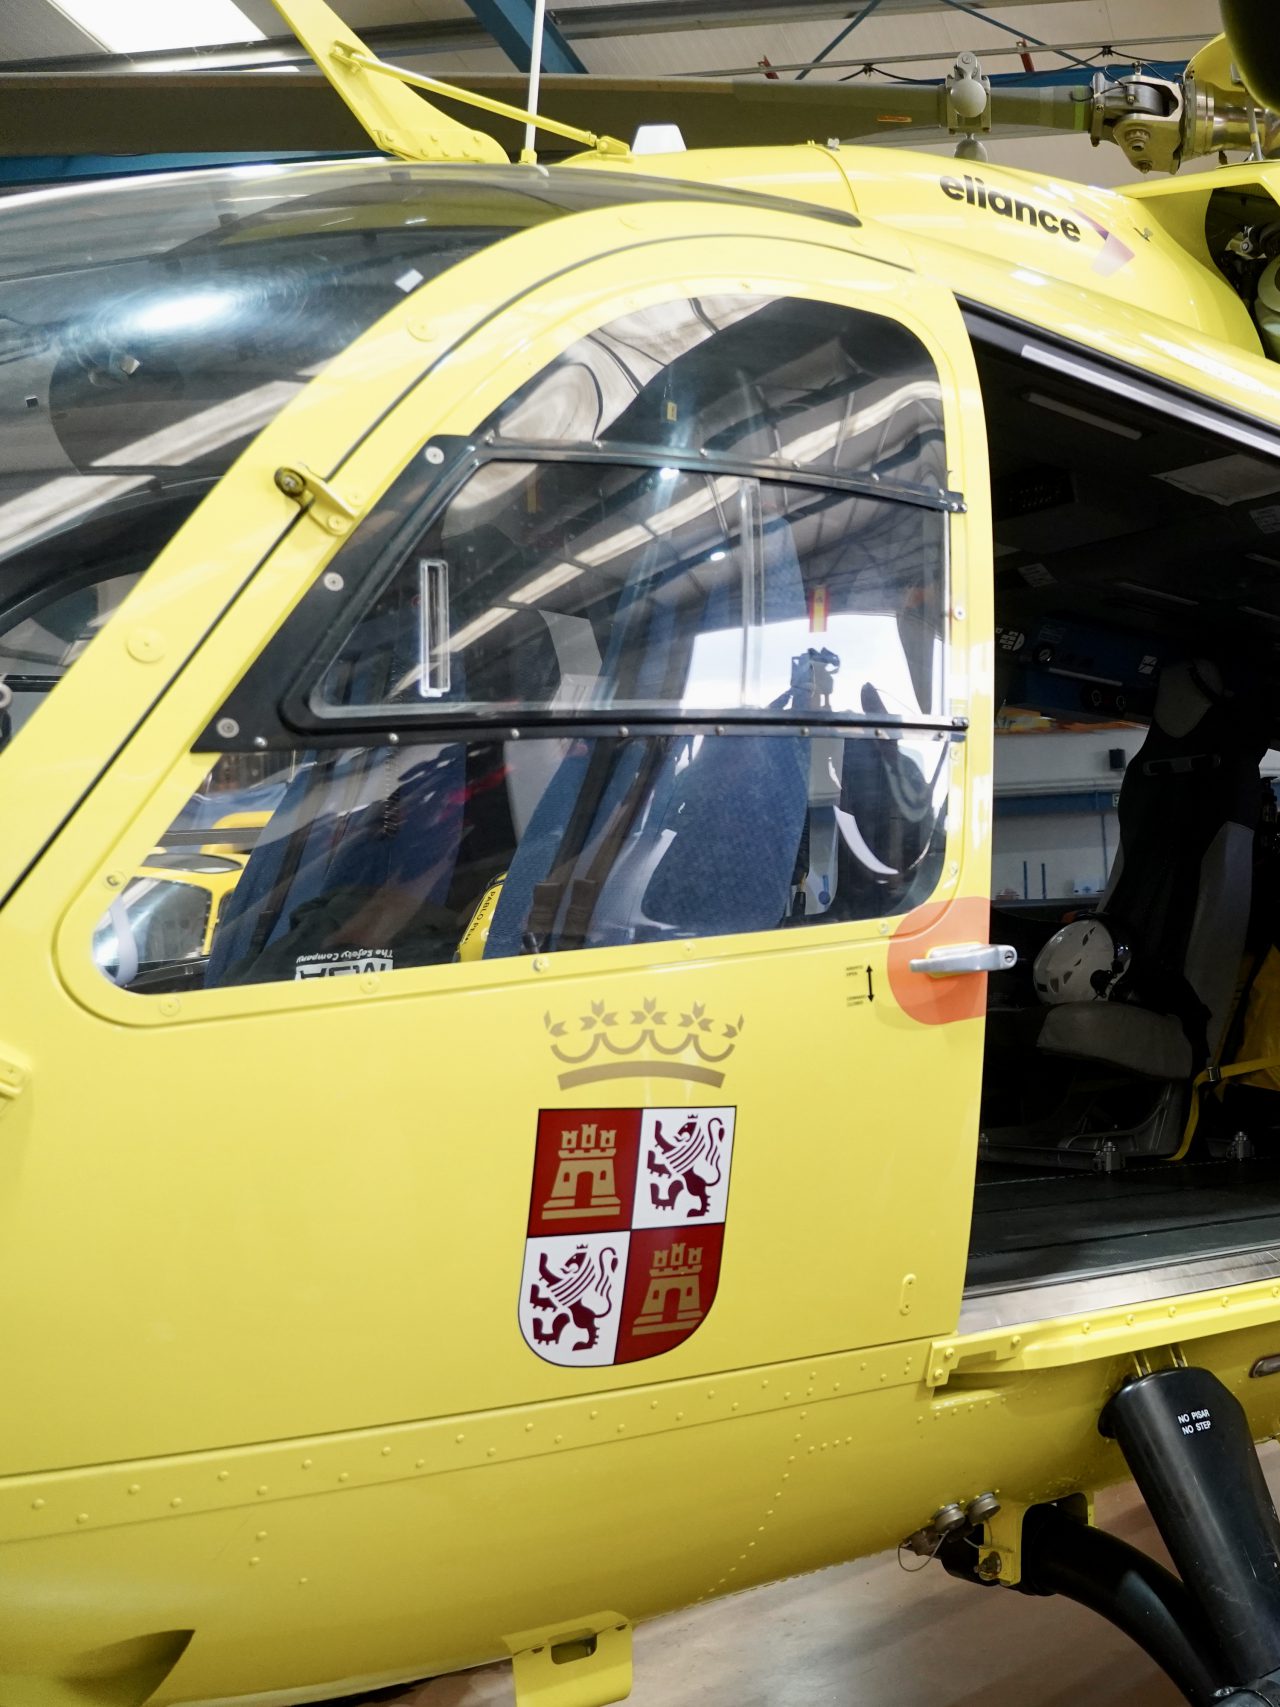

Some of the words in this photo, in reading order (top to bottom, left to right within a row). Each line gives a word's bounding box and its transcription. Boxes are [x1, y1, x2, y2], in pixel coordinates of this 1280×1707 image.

[939, 174, 1081, 242] eliance
[296, 952, 340, 964] Company
[341, 948, 373, 960] Safety
[375, 948, 394, 958] The
[1177, 1413, 1190, 1424] NO
[1191, 1409, 1211, 1420] PISAR
[1181, 1424, 1194, 1435] NO
[1195, 1420, 1212, 1431] STEP
